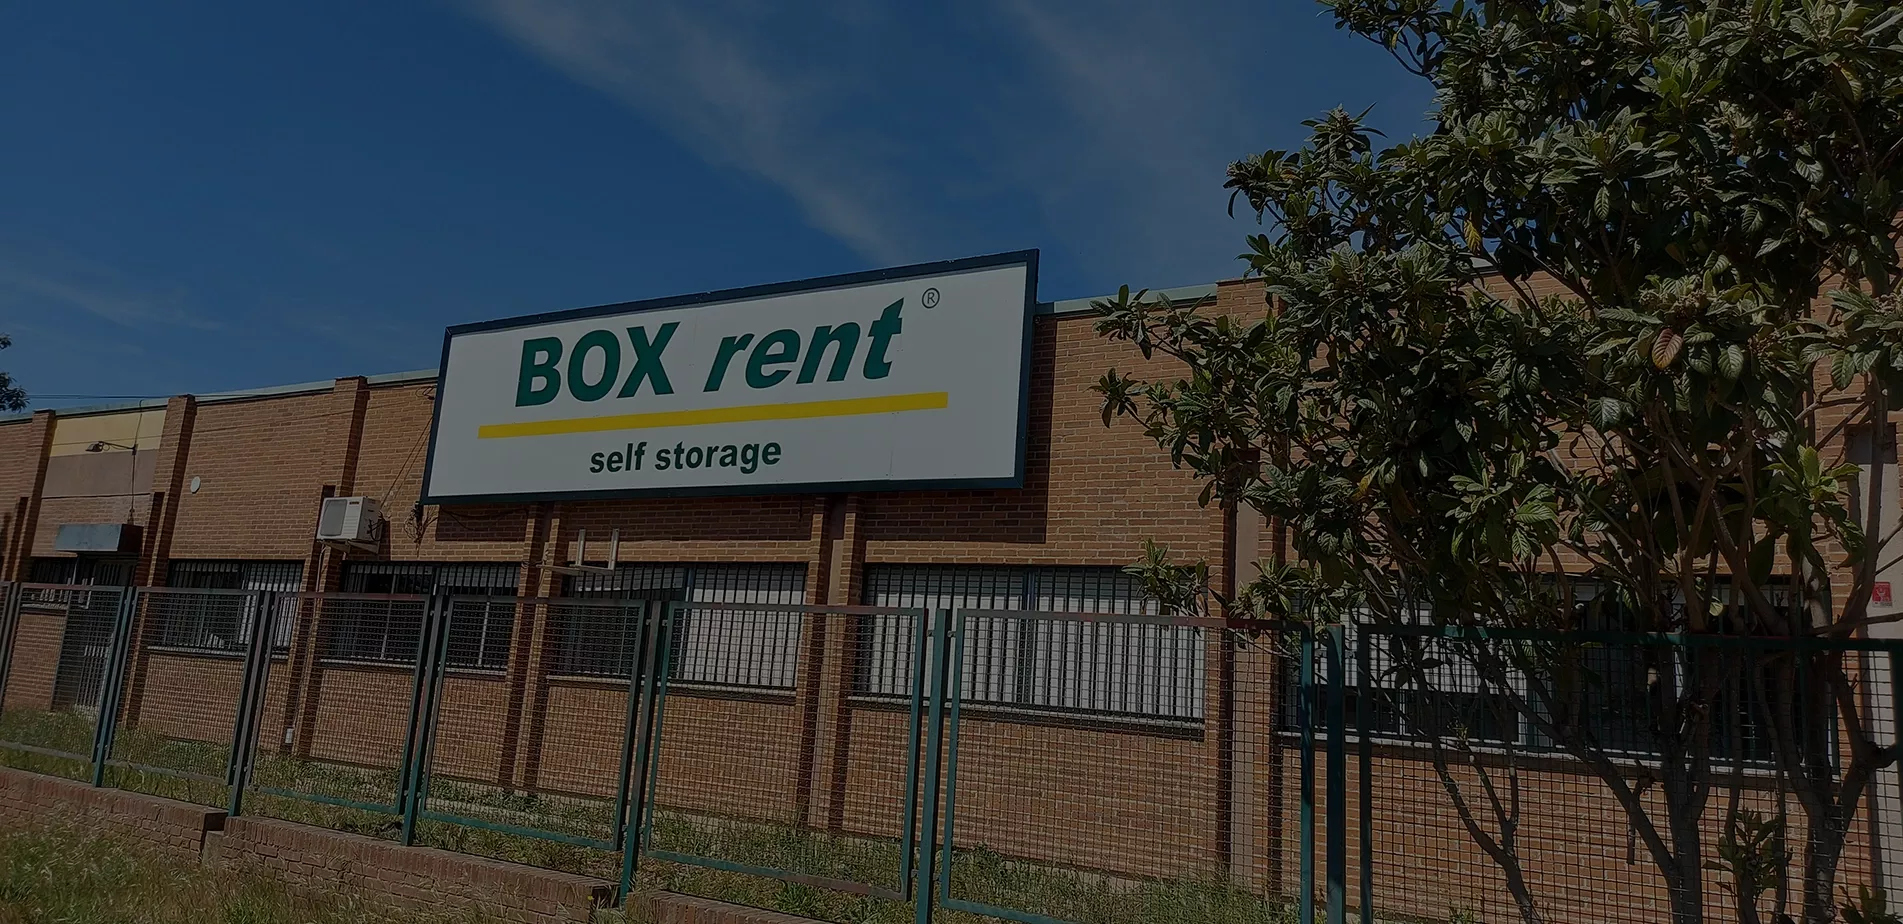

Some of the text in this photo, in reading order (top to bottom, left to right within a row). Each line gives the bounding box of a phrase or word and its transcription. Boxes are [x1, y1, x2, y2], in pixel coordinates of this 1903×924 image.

[515, 321, 680, 407] BOX
[703, 297, 905, 392] rent
[589, 441, 782, 474] self storage
